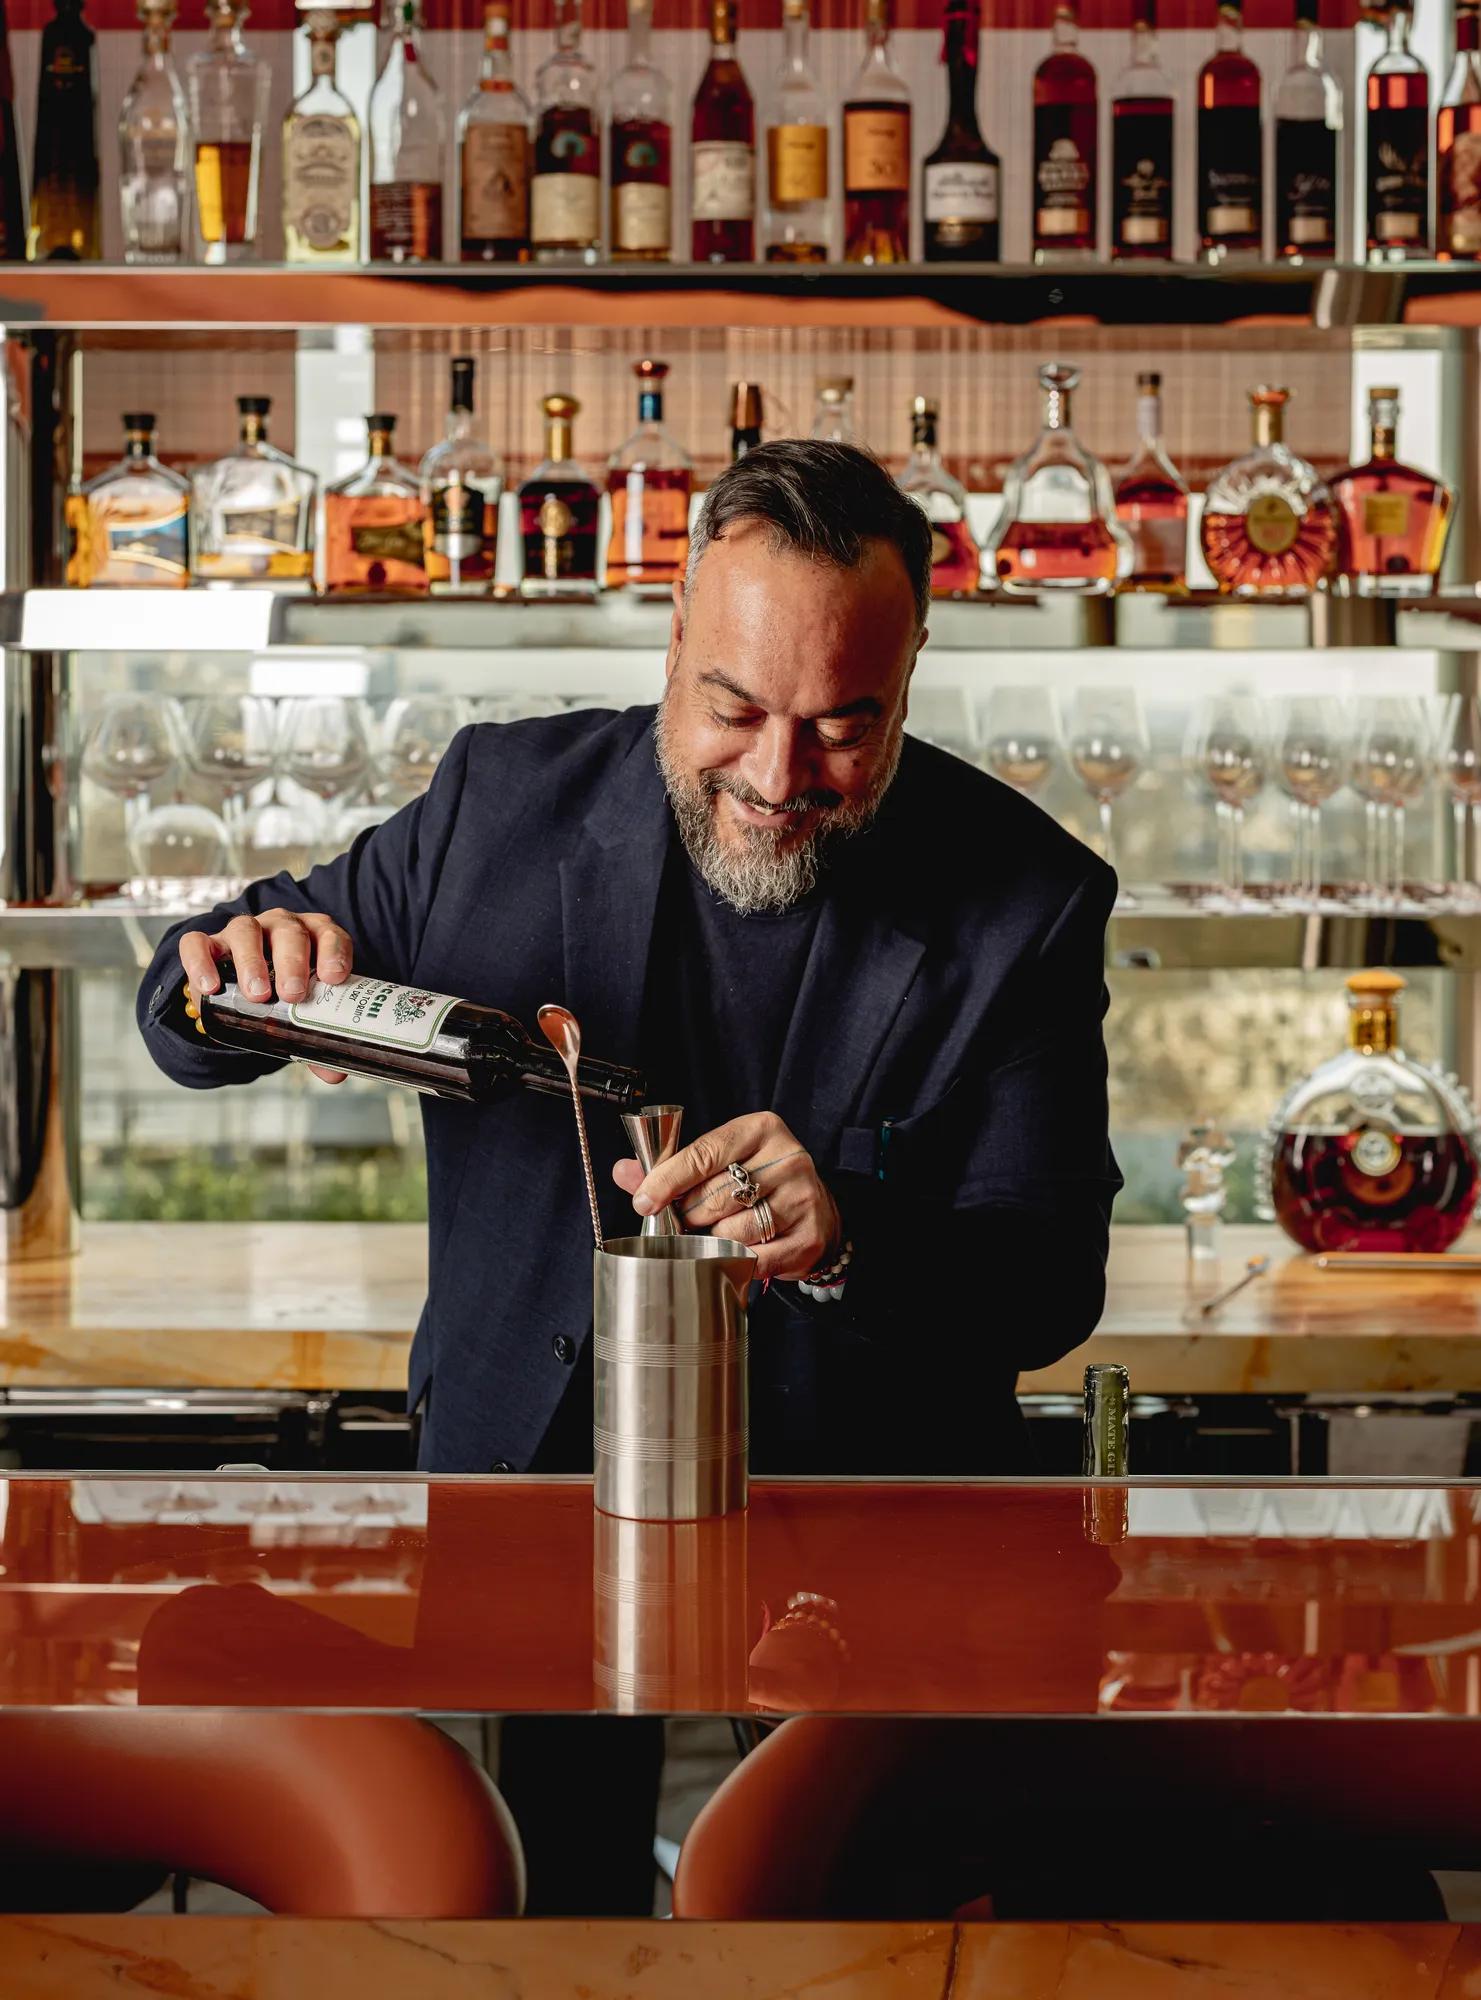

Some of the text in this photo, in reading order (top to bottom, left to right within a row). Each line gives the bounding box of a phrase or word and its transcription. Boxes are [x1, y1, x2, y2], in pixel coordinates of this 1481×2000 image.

[352, 996, 371, 1023] TORINO
[366, 984, 400, 1019] OCCHI
[1108, 1407, 1116, 1449] MATE
